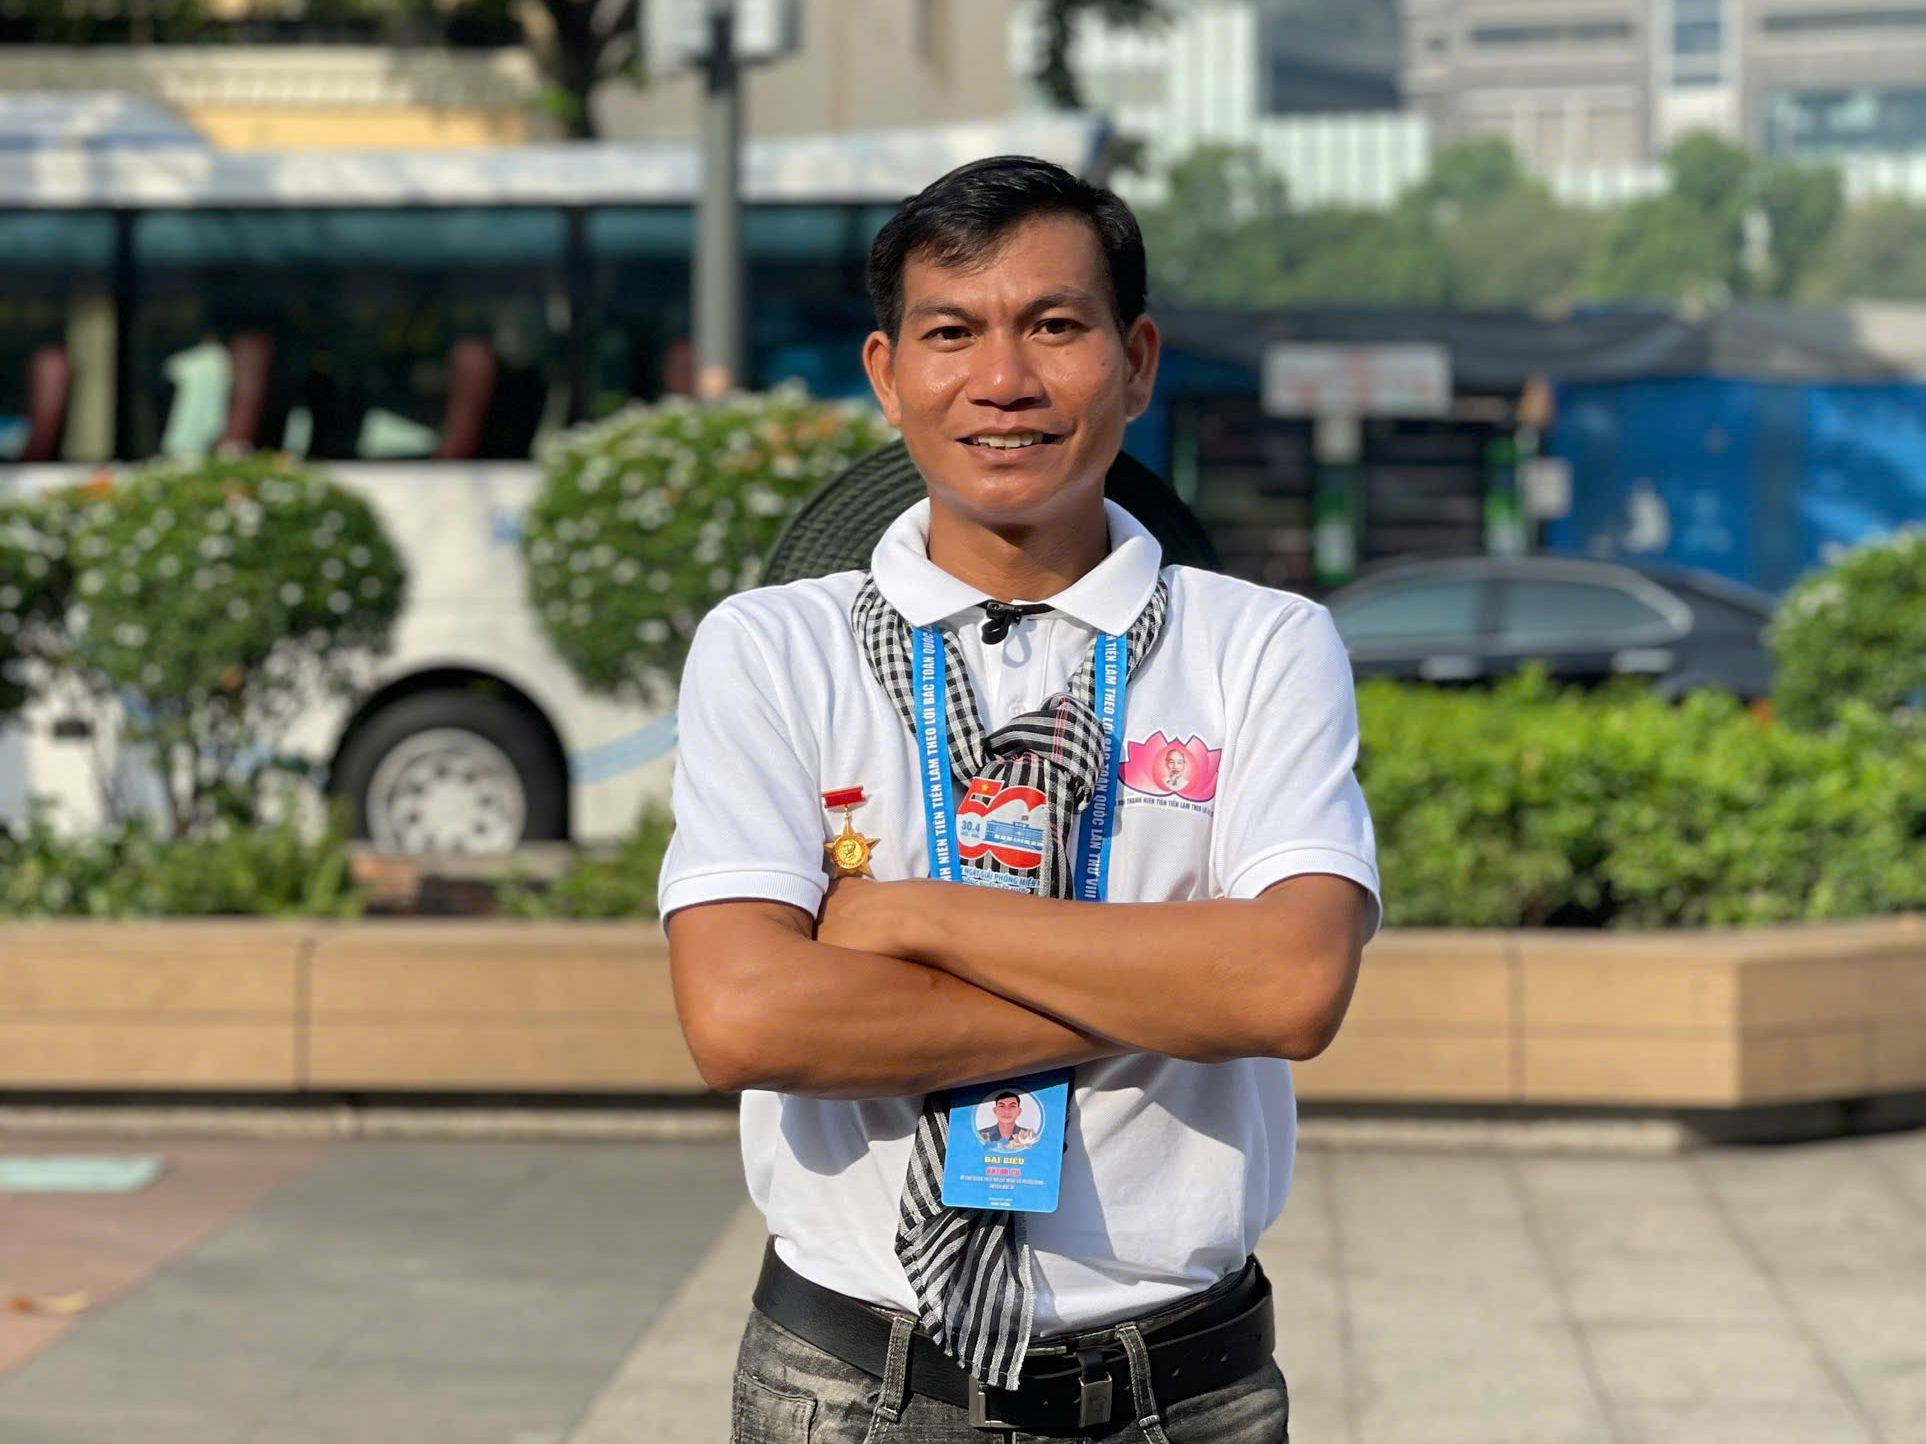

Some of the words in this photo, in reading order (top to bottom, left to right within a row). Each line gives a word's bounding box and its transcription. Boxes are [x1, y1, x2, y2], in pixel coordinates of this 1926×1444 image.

[1103, 688, 1116, 715] THEO
[924, 728, 939, 757] THEO
[933, 811, 946, 836] TIÊN
[961, 821, 980, 832] 30.4
[936, 838, 949, 864] NIÊN
[1084, 878, 1098, 898] VIII
